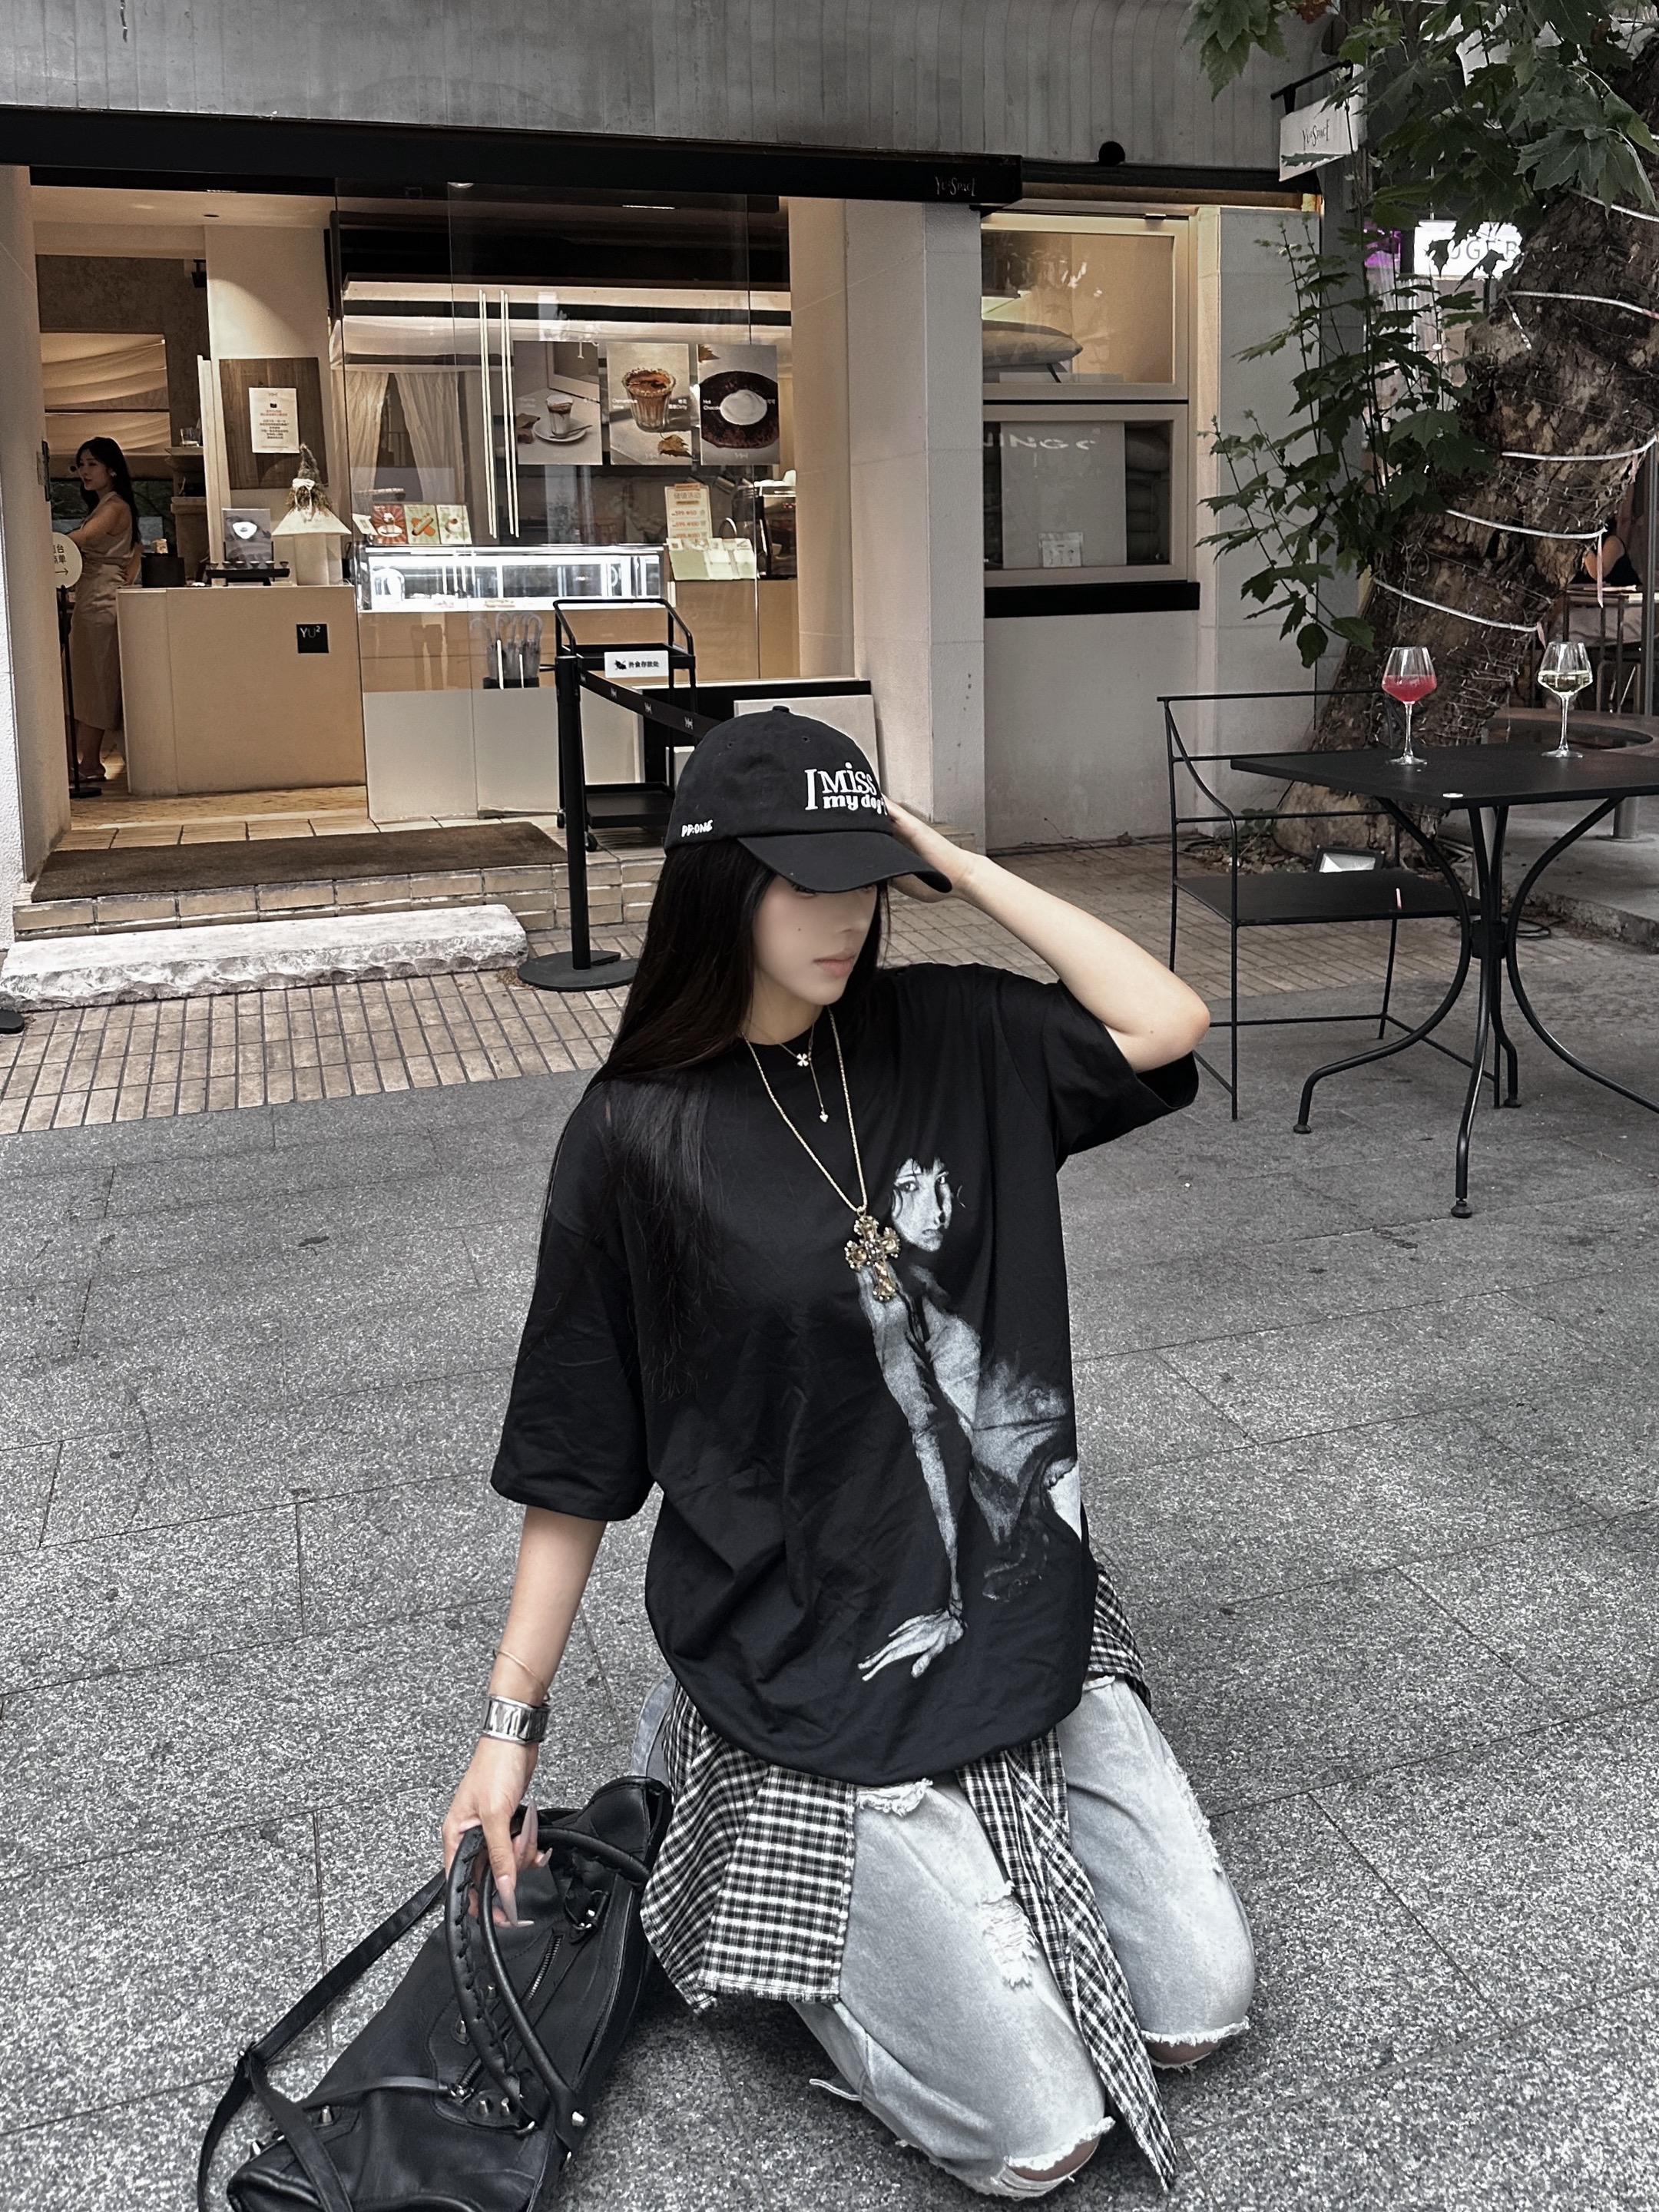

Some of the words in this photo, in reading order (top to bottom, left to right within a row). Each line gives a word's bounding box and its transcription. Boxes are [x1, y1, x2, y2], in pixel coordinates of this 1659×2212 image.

[804, 768, 819, 810] I
[817, 762, 877, 796] Miss
[823, 794, 859, 811] my
